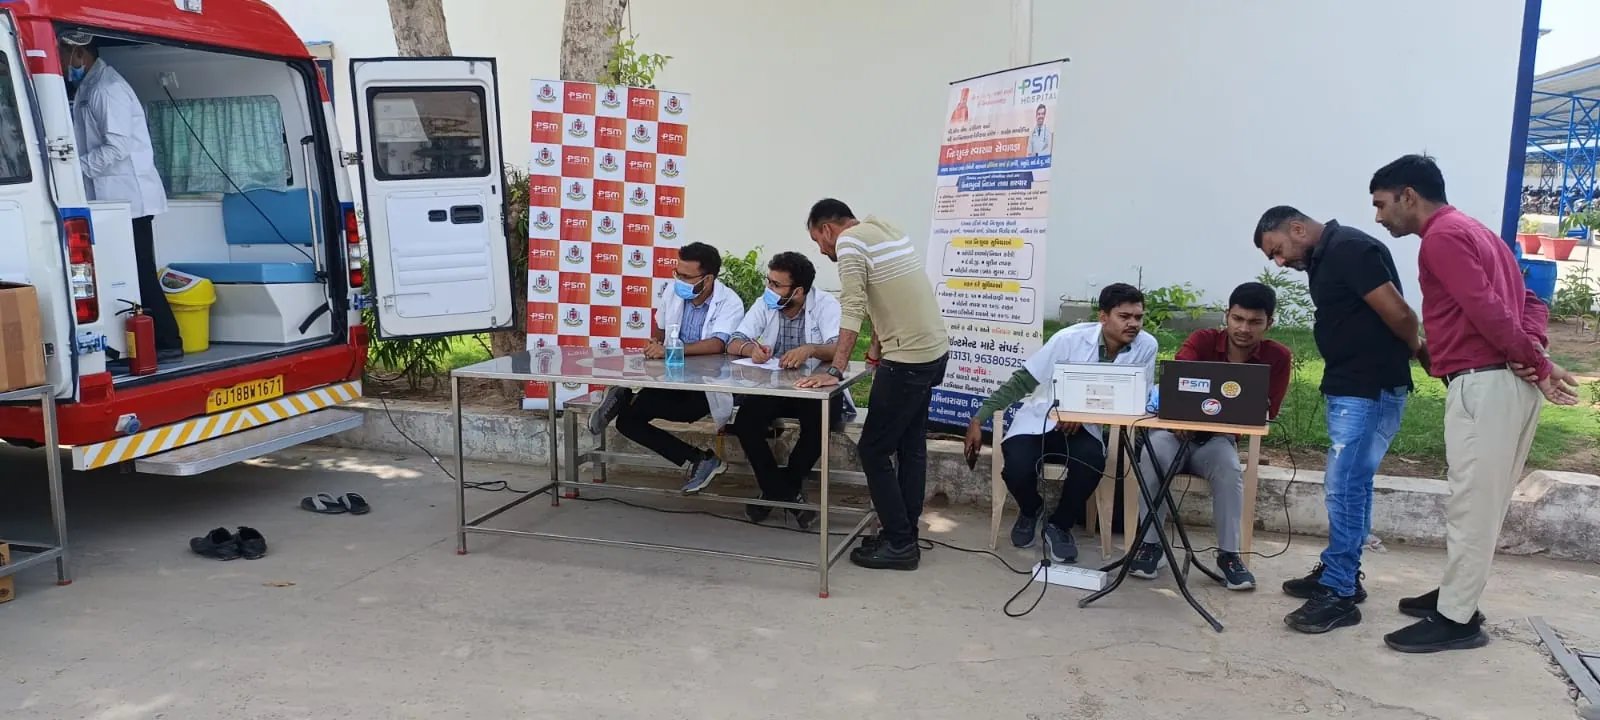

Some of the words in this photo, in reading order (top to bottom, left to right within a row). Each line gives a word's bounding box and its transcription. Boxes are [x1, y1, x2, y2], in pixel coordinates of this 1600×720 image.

[1018, 74, 1059, 95] PSM
[1020, 92, 1057, 104] HOSPITAL
[980, 338, 996, 350] માટે
[999, 340, 1020, 354] સંપર્ક
[216, 378, 281, 407] GJ18BW1671
